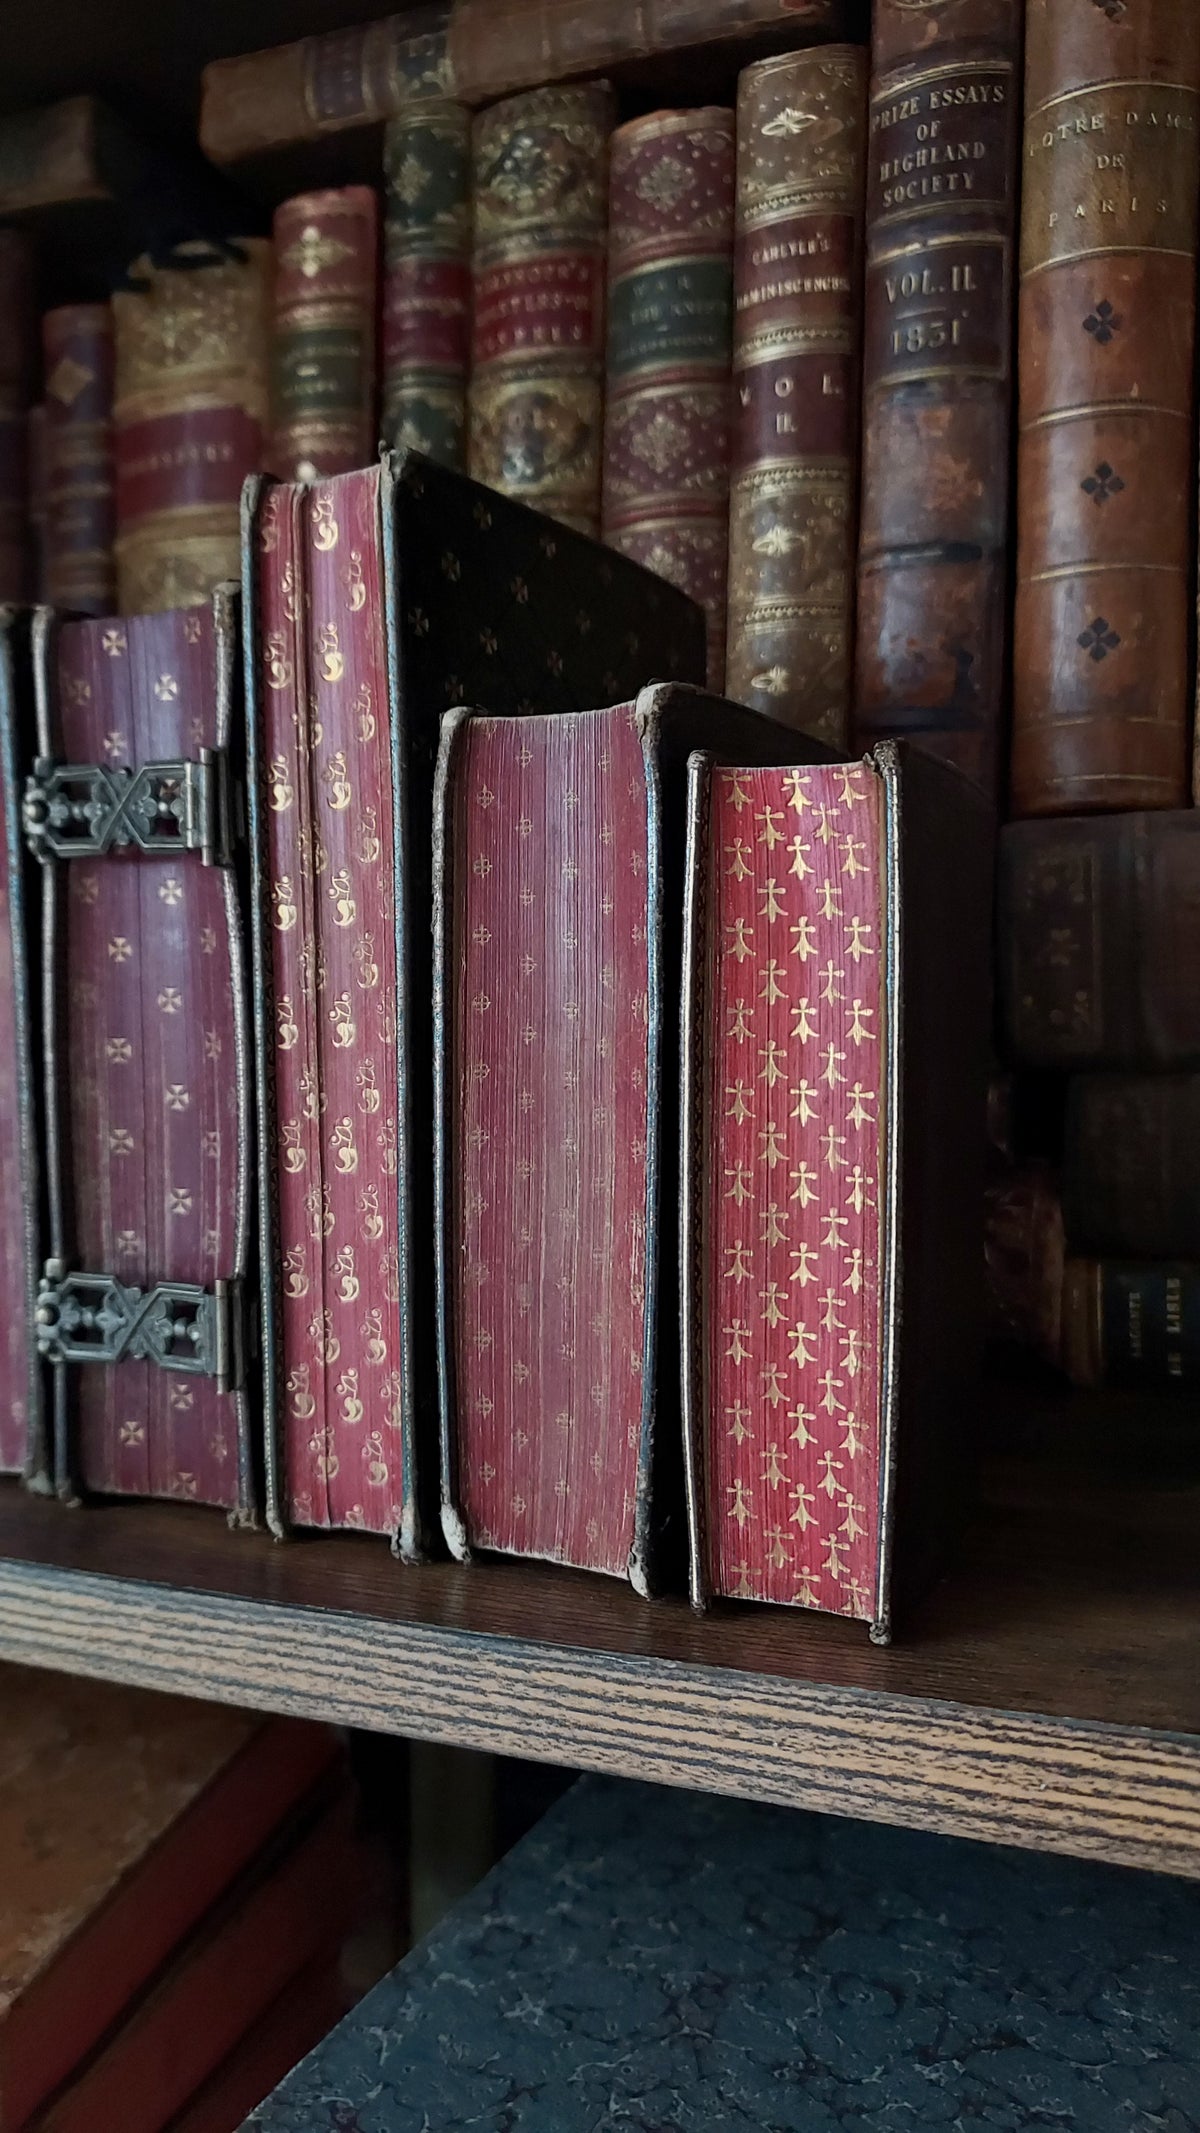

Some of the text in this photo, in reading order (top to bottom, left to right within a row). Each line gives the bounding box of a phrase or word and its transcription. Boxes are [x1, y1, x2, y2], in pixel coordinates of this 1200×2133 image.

[872, 85, 1005, 133] PRIZE ESSAYS
[916, 120, 941, 142] OF
[880, 141, 986, 182] HIGHLAND
[883, 172, 973, 208] SOCIETY
[1048, 197, 1168, 227] PARIS
[752, 232, 830, 266] CARLYLE'S
